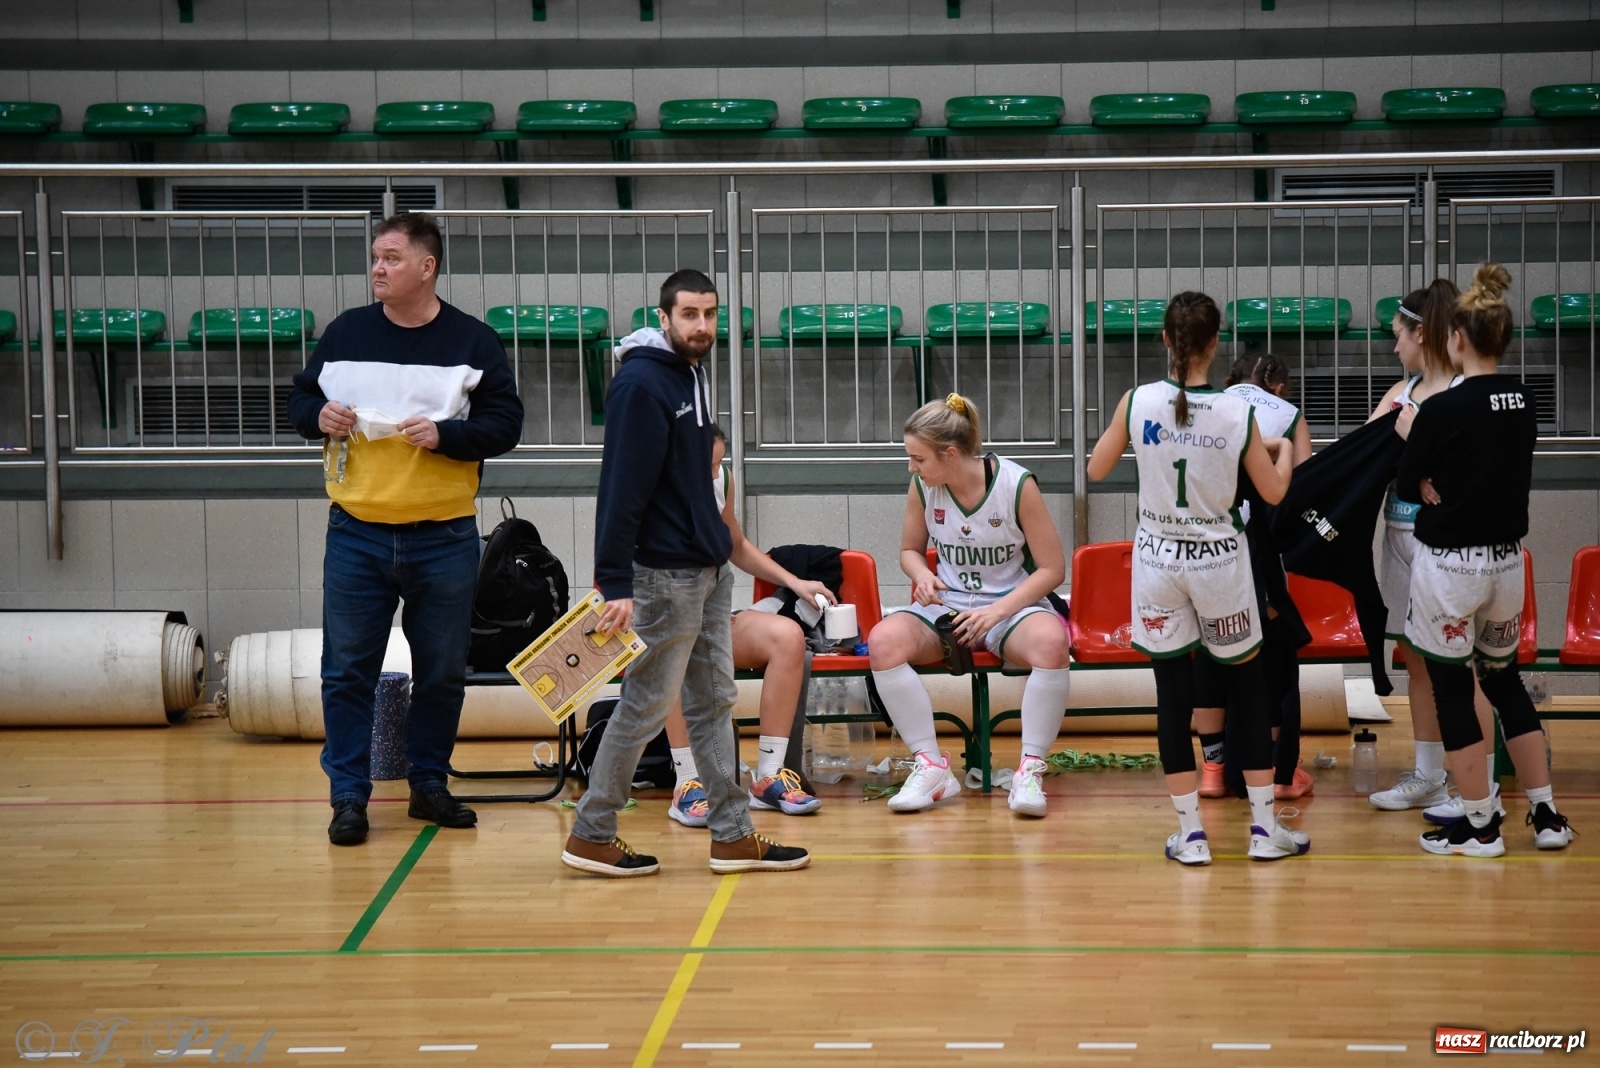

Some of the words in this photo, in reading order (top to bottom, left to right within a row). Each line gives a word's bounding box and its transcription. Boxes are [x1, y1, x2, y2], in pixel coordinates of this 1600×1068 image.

[1490, 393, 1525, 411] STEC
[1142, 419, 1227, 450] KOMPLIDO
[1172, 458, 1189, 508] 1
[1142, 508, 1157, 521] AZS
[1159, 514, 1173, 524] UŚ
[958, 571, 983, 591] 25
[1216, 609, 1251, 638] DEFIN
